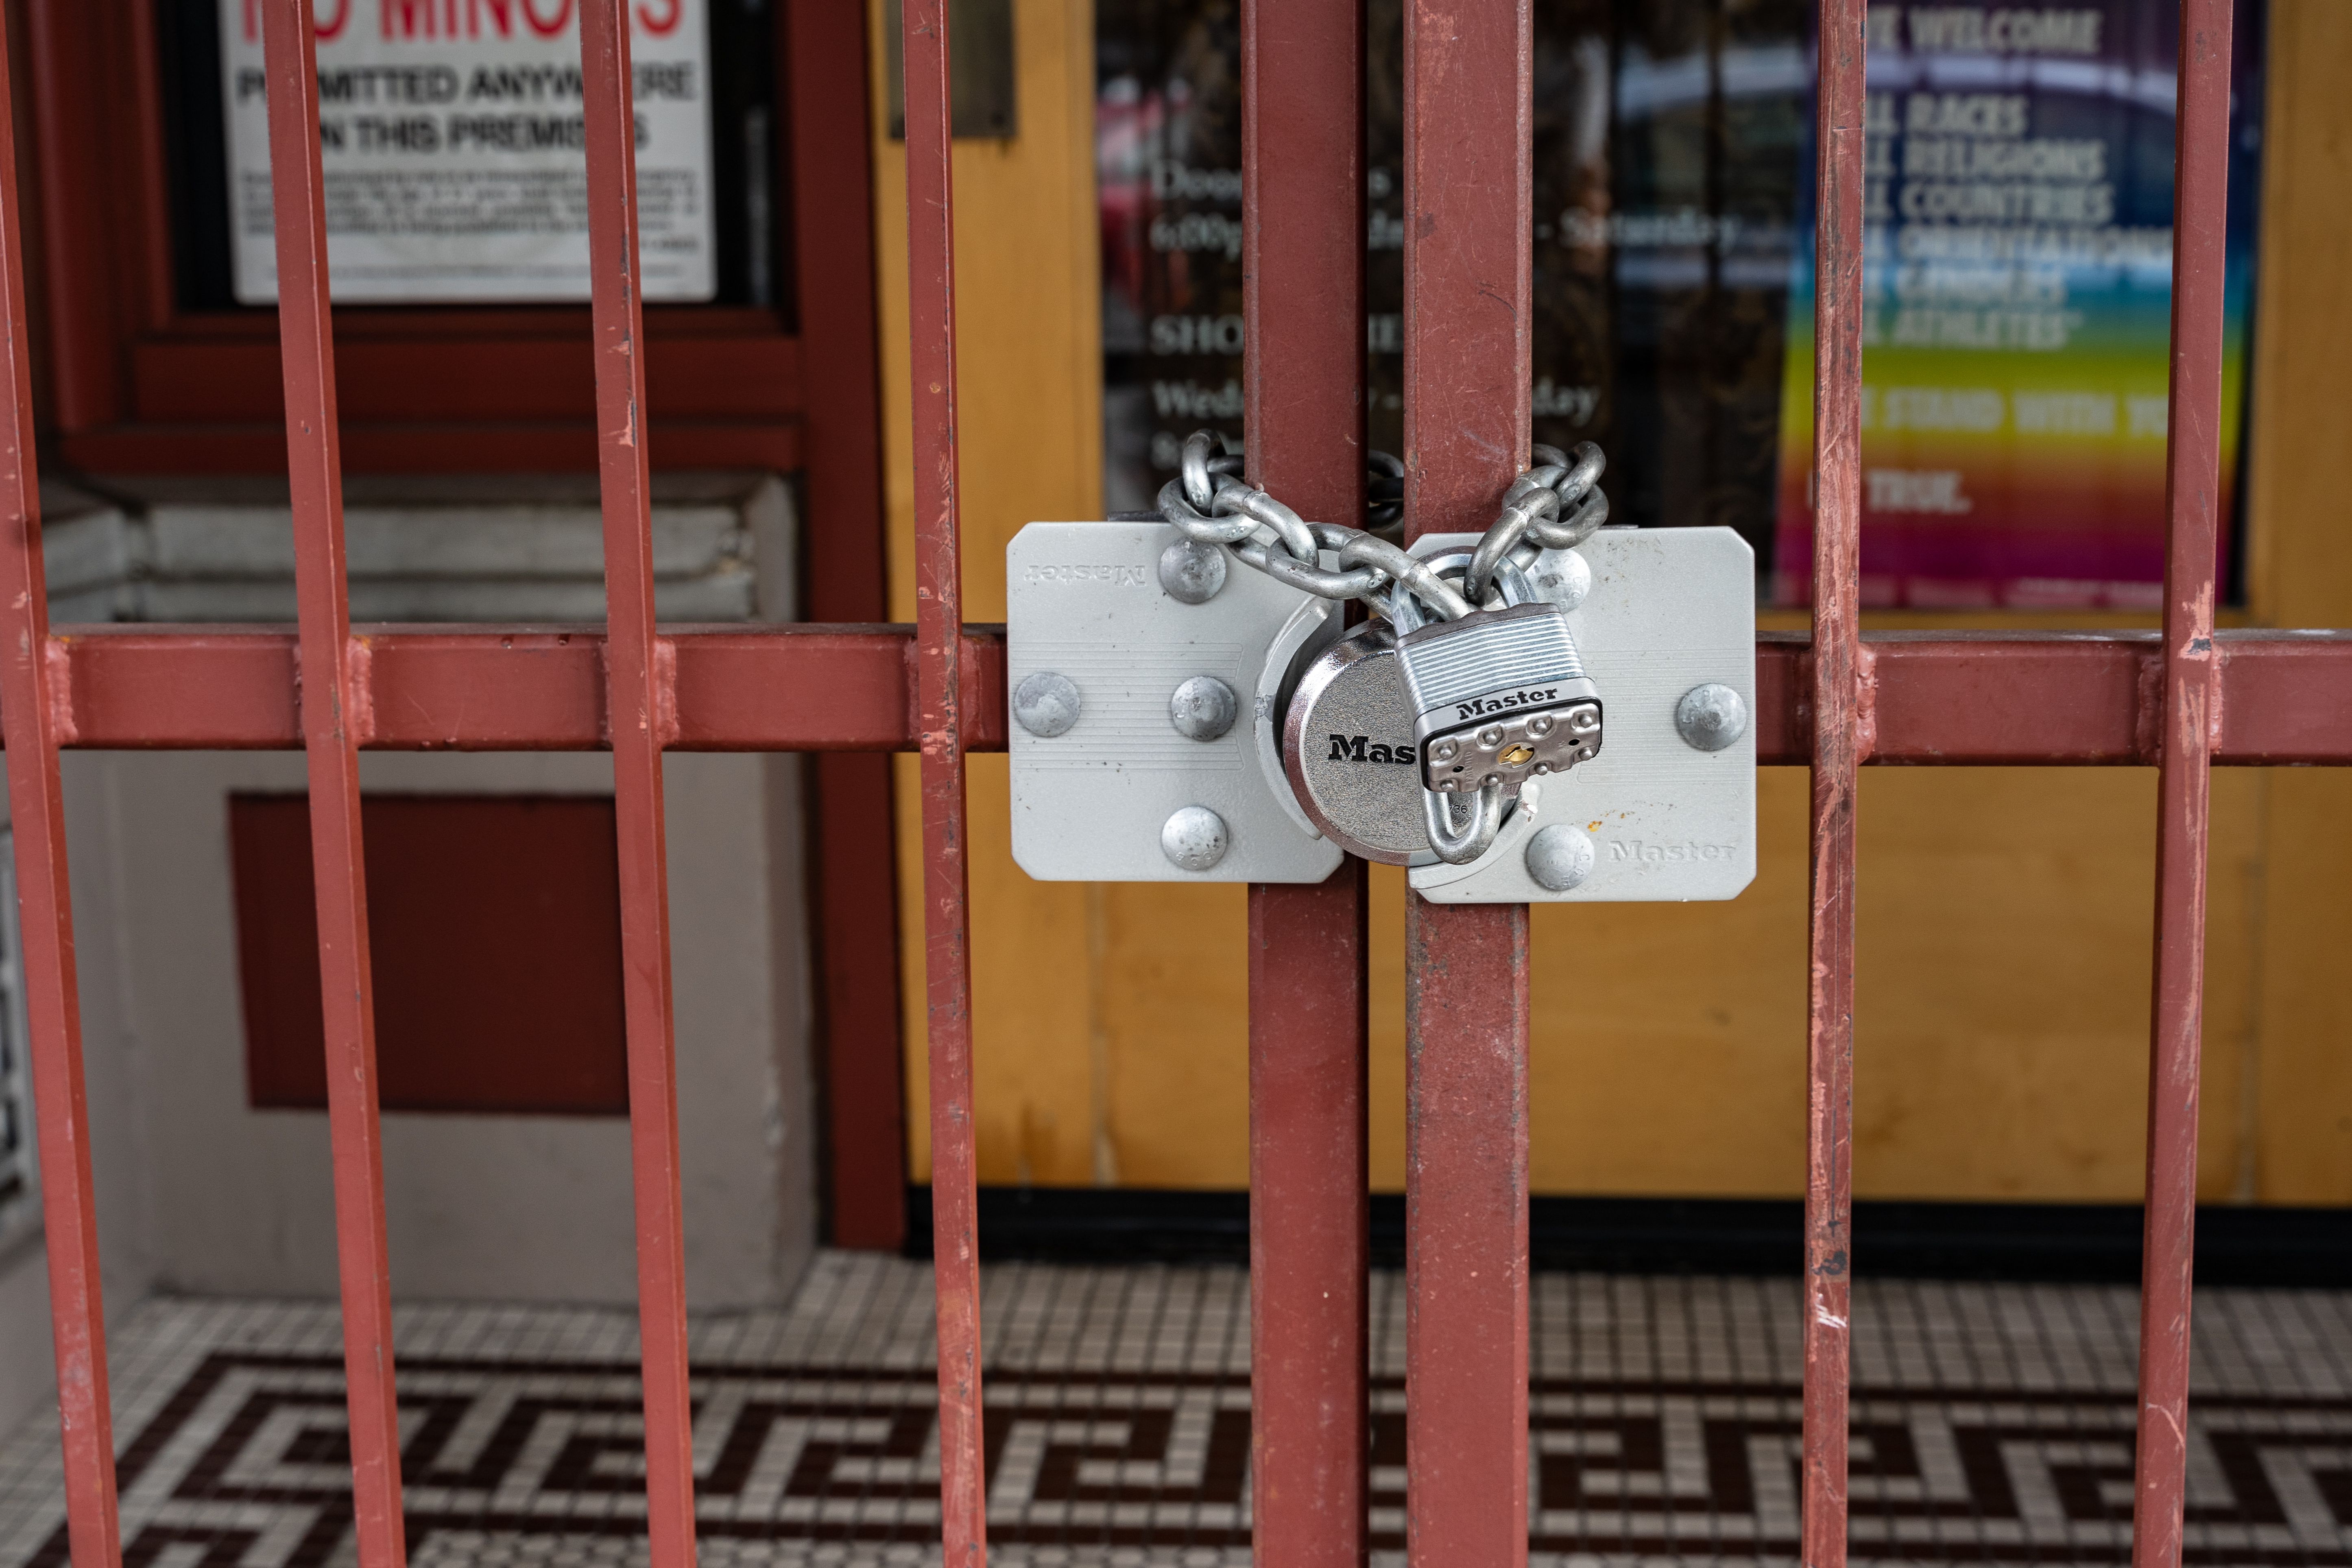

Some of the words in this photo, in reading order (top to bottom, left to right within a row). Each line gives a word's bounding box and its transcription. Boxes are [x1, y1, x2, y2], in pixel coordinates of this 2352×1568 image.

[1908, 9, 2103, 54] WELCOME
[237, 63, 460, 107] PMITTED
[354, 112, 442, 155] THIS
[447, 110, 650, 154] PREMISS
[1905, 94, 2027, 136] RACES
[1901, 138, 2106, 180] RELIGIONS
[1898, 182, 2114, 224] COUNTRIES
[1024, 565, 1145, 587] Master
[1456, 688, 1558, 720] Master
[1328, 734, 1416, 765] Mas
[1608, 840, 1737, 861] Master
